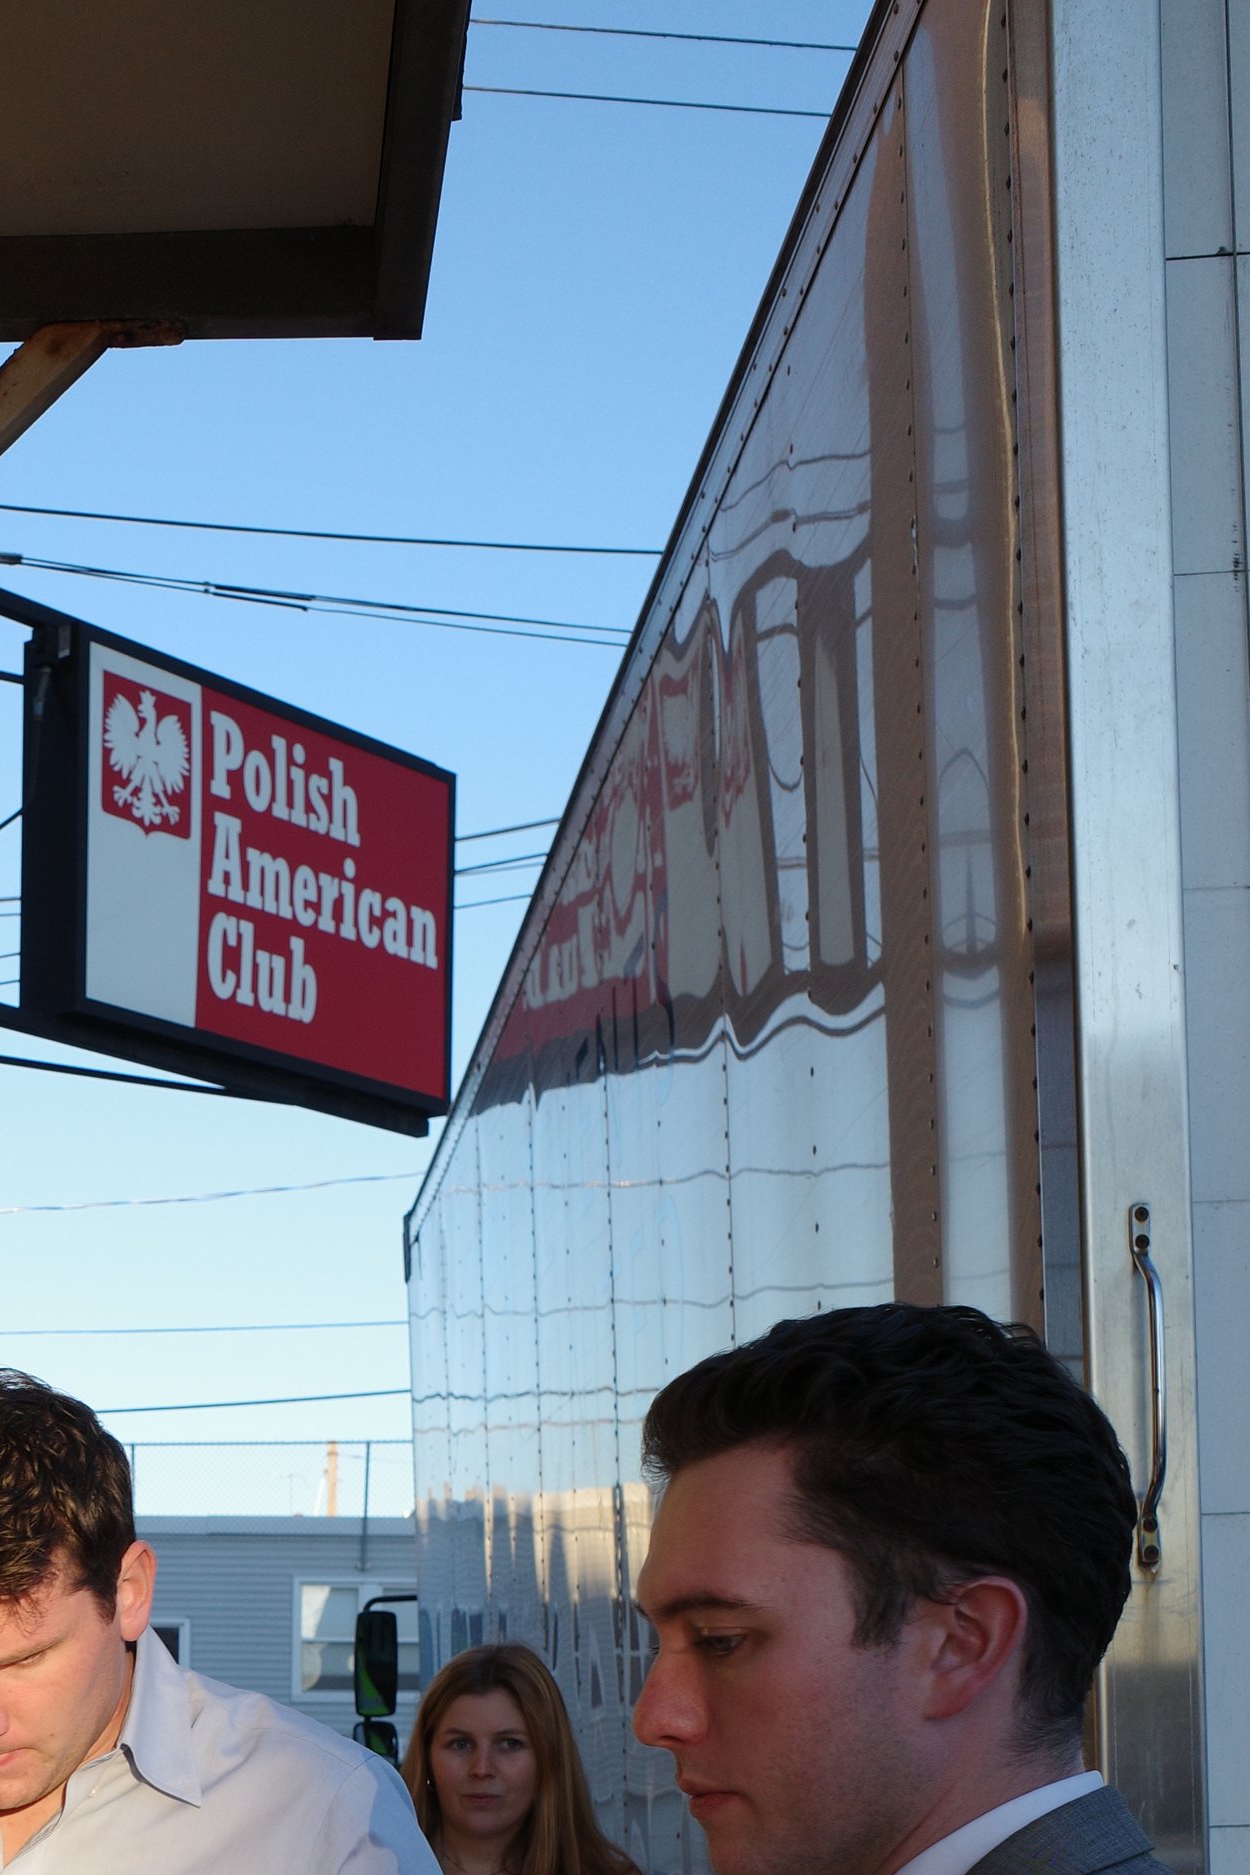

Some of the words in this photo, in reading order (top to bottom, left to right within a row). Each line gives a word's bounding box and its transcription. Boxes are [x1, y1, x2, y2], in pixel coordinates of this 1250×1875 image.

[210, 710, 361, 847] Polish
[207, 811, 438, 970] American
[207, 911, 317, 1024] Club
